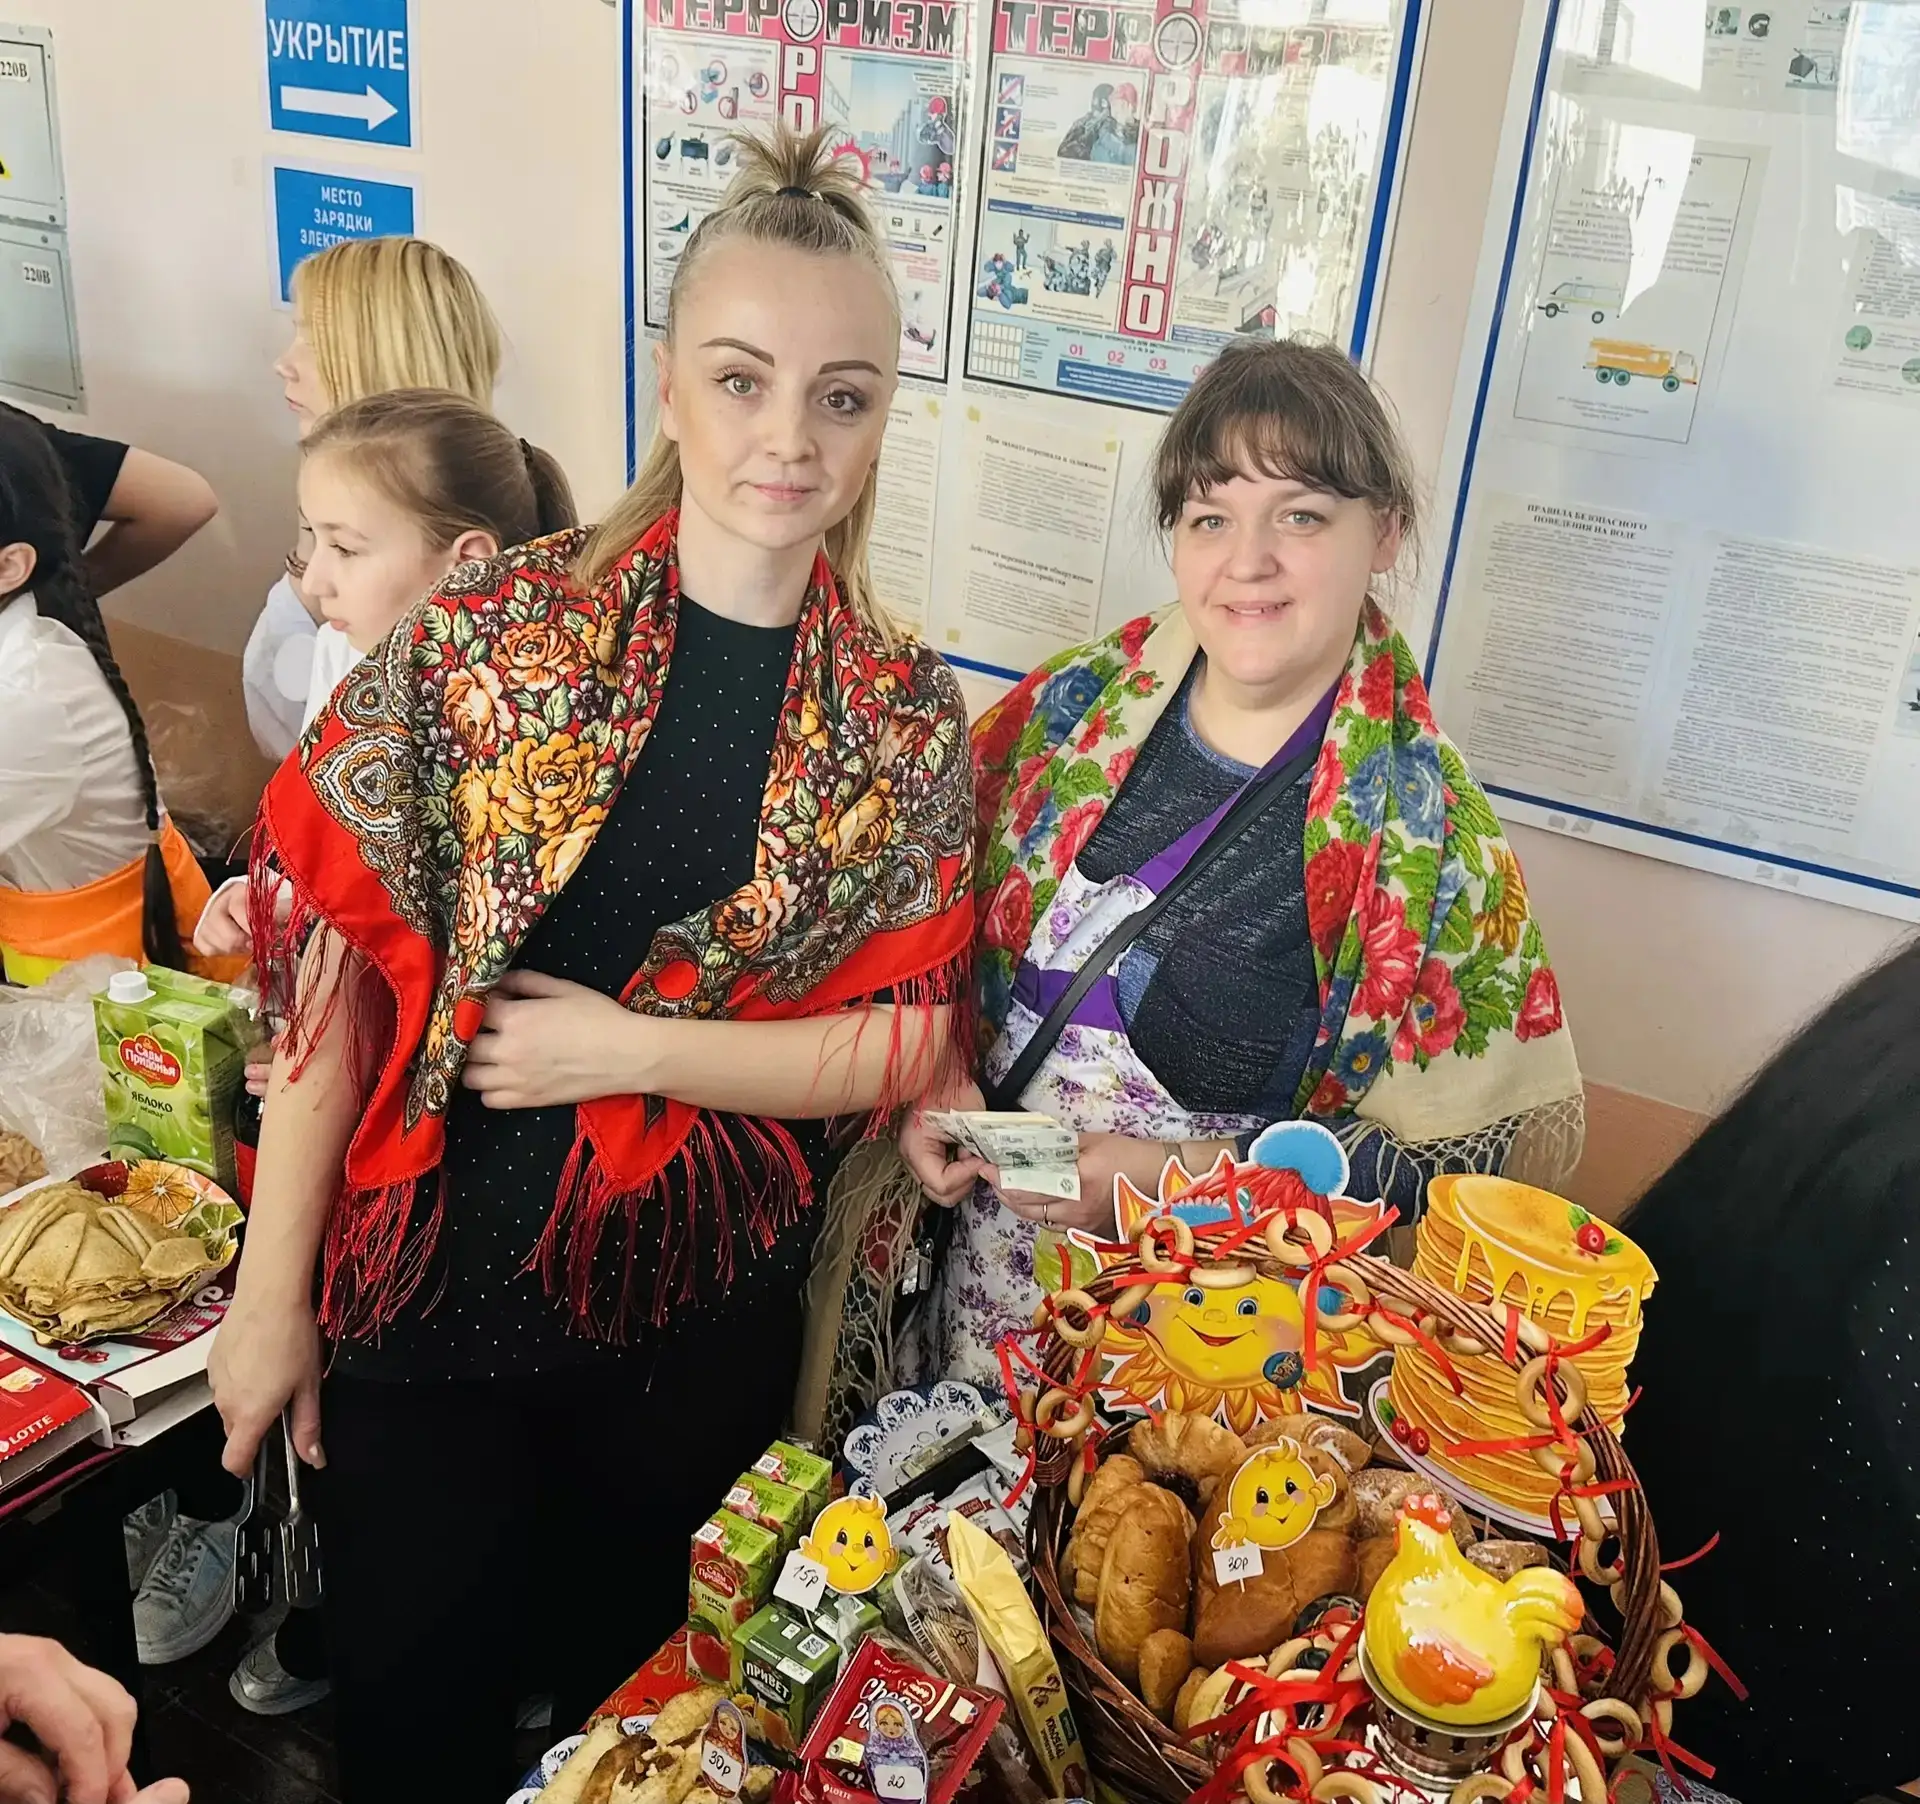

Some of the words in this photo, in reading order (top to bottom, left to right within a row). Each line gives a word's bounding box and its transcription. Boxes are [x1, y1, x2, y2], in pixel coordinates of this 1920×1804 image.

[268, 18, 405, 71] УКРЫТИЕ
[0, 61, 28, 77] 220В
[321, 185, 362, 208] МЕСТО
[314, 208, 373, 233] ЗАРЯДКИ
[23, 266, 51, 284] 220В
[1069, 344, 1084, 356] 01
[1107, 350, 1125, 364] 02
[1149, 358, 1167, 371] 03
[1527, 503, 1573, 519] ПРАВИЛА
[1574, 512, 1648, 531] БЕЗОПАСНОГО
[1533, 514, 1592, 532] ПОВЕДЕНИЯ
[1593, 526, 1608, 535] НА
[1609, 528, 1637, 540] ВОДЕ
[125, 1048, 176, 1077] Придонья
[135, 1042, 163, 1064] Сады
[131, 1091, 173, 1113] ЯБЛОКО
[9, 1414, 54, 1445] LOTTE
[706, 1565, 726, 1583] Сады
[746, 1661, 790, 1699] ПРИВЕТ
[845, 1702, 870, 1731] Pi
